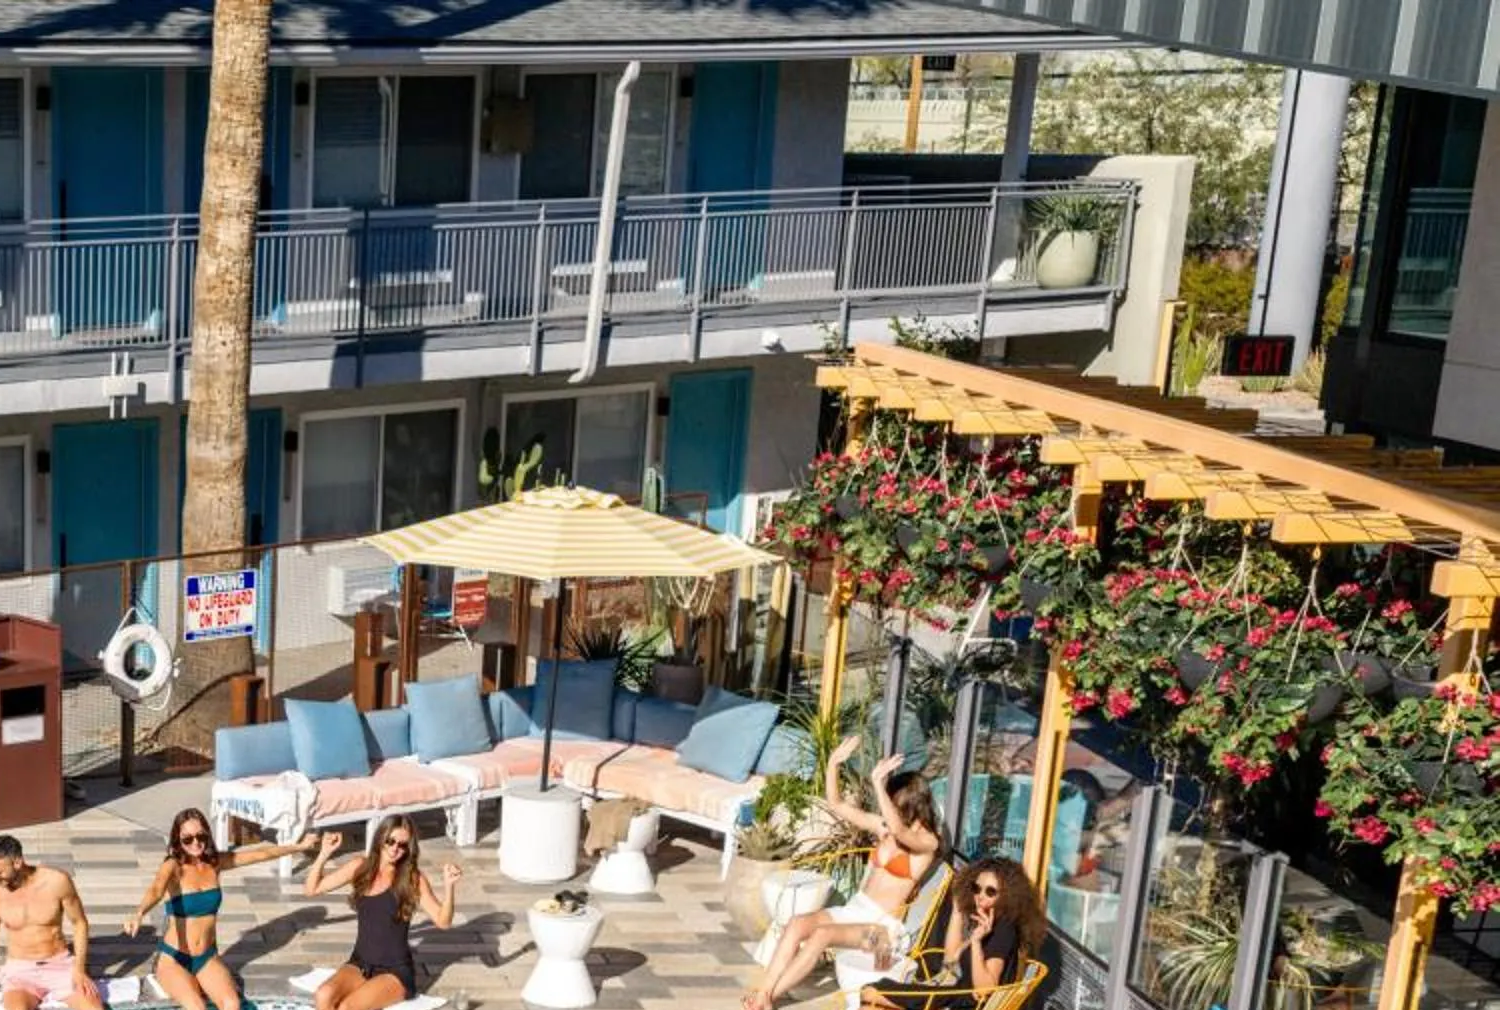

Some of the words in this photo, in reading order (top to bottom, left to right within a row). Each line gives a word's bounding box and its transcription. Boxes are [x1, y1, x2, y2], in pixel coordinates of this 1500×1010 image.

[1238, 341, 1285, 374] EXIT
[199, 573, 244, 593] WARNING
[187, 597, 200, 611] NO
[202, 590, 252, 610] LIFEGUARD
[199, 613, 213, 629] ON
[217, 608, 240, 626] DUTY
